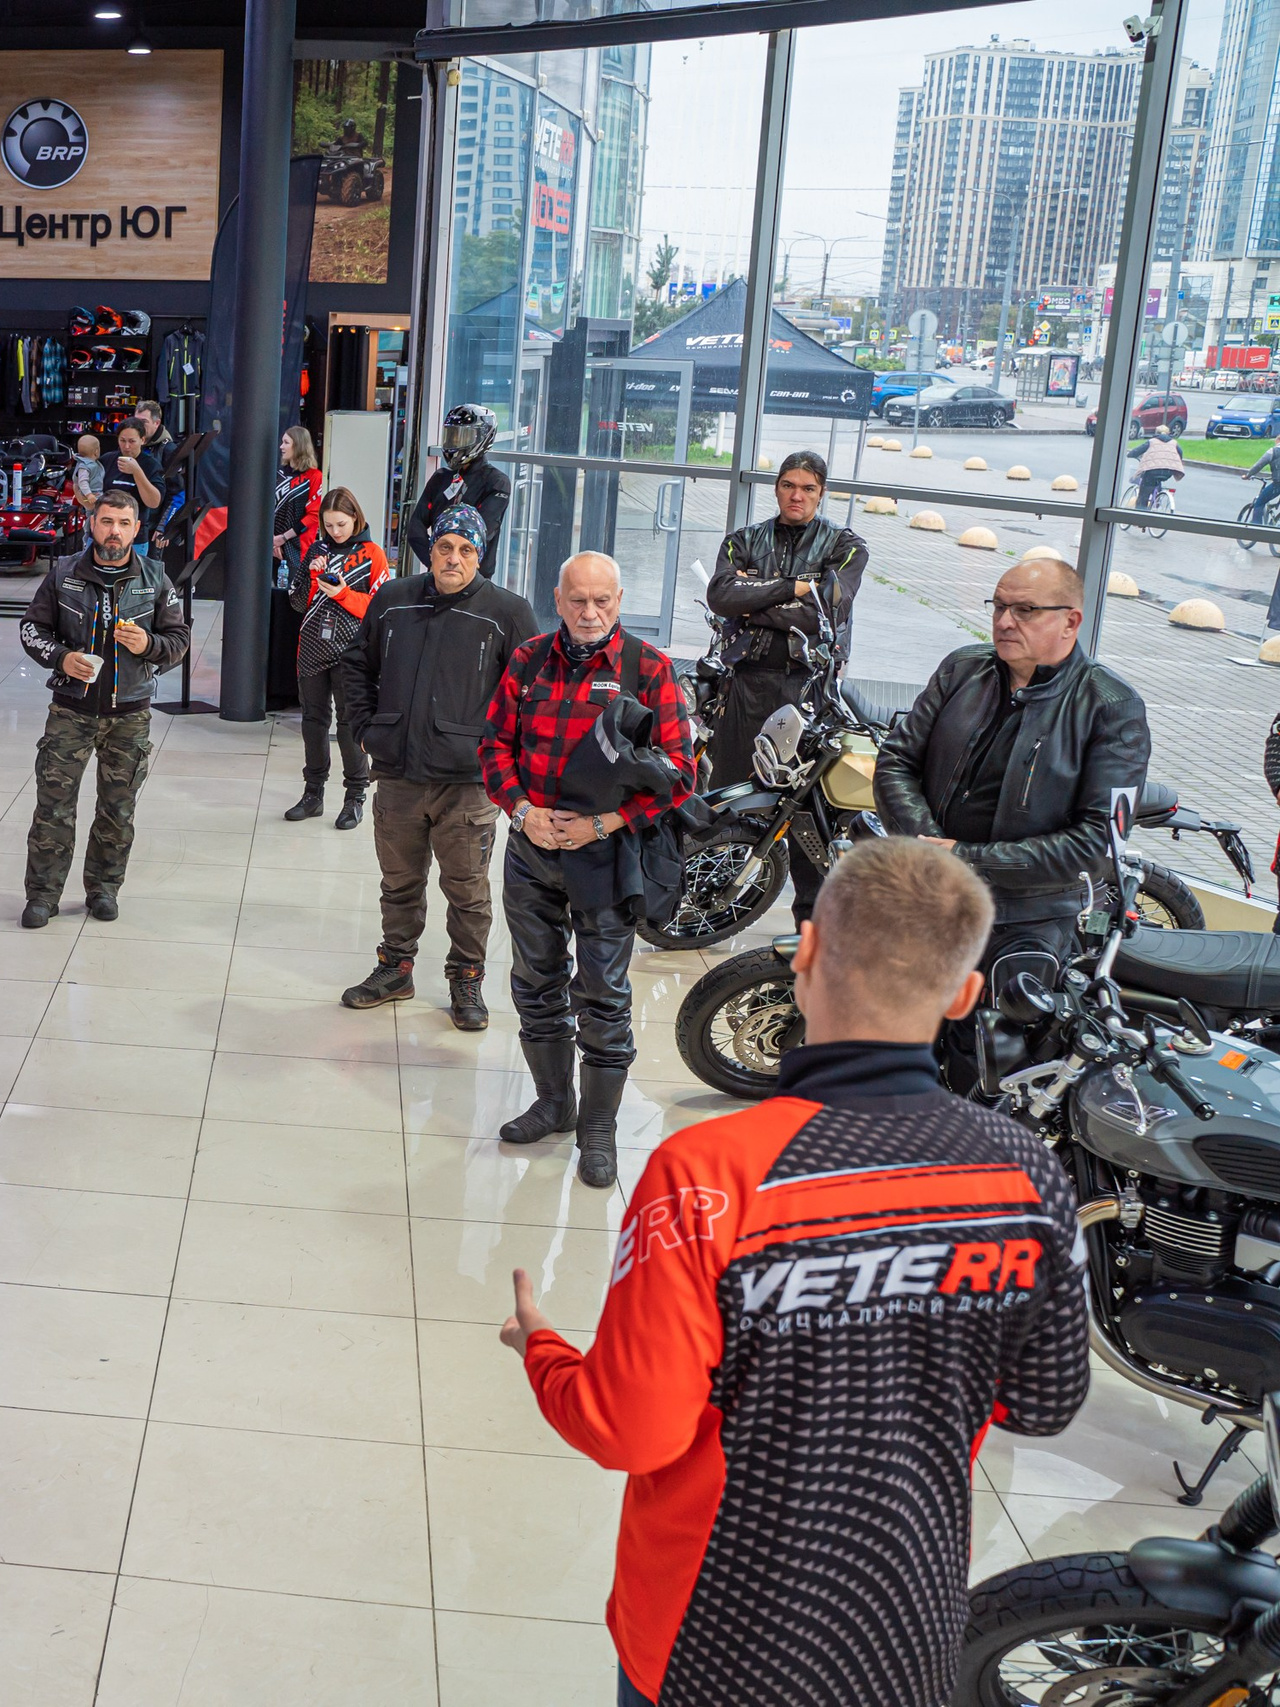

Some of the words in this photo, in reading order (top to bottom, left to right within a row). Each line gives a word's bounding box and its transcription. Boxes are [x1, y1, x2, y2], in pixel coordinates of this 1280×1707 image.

[35, 146, 85, 161] BRP
[120, 205, 187, 239] ЮГ
[740, 1238, 1043, 1314] VETERR
